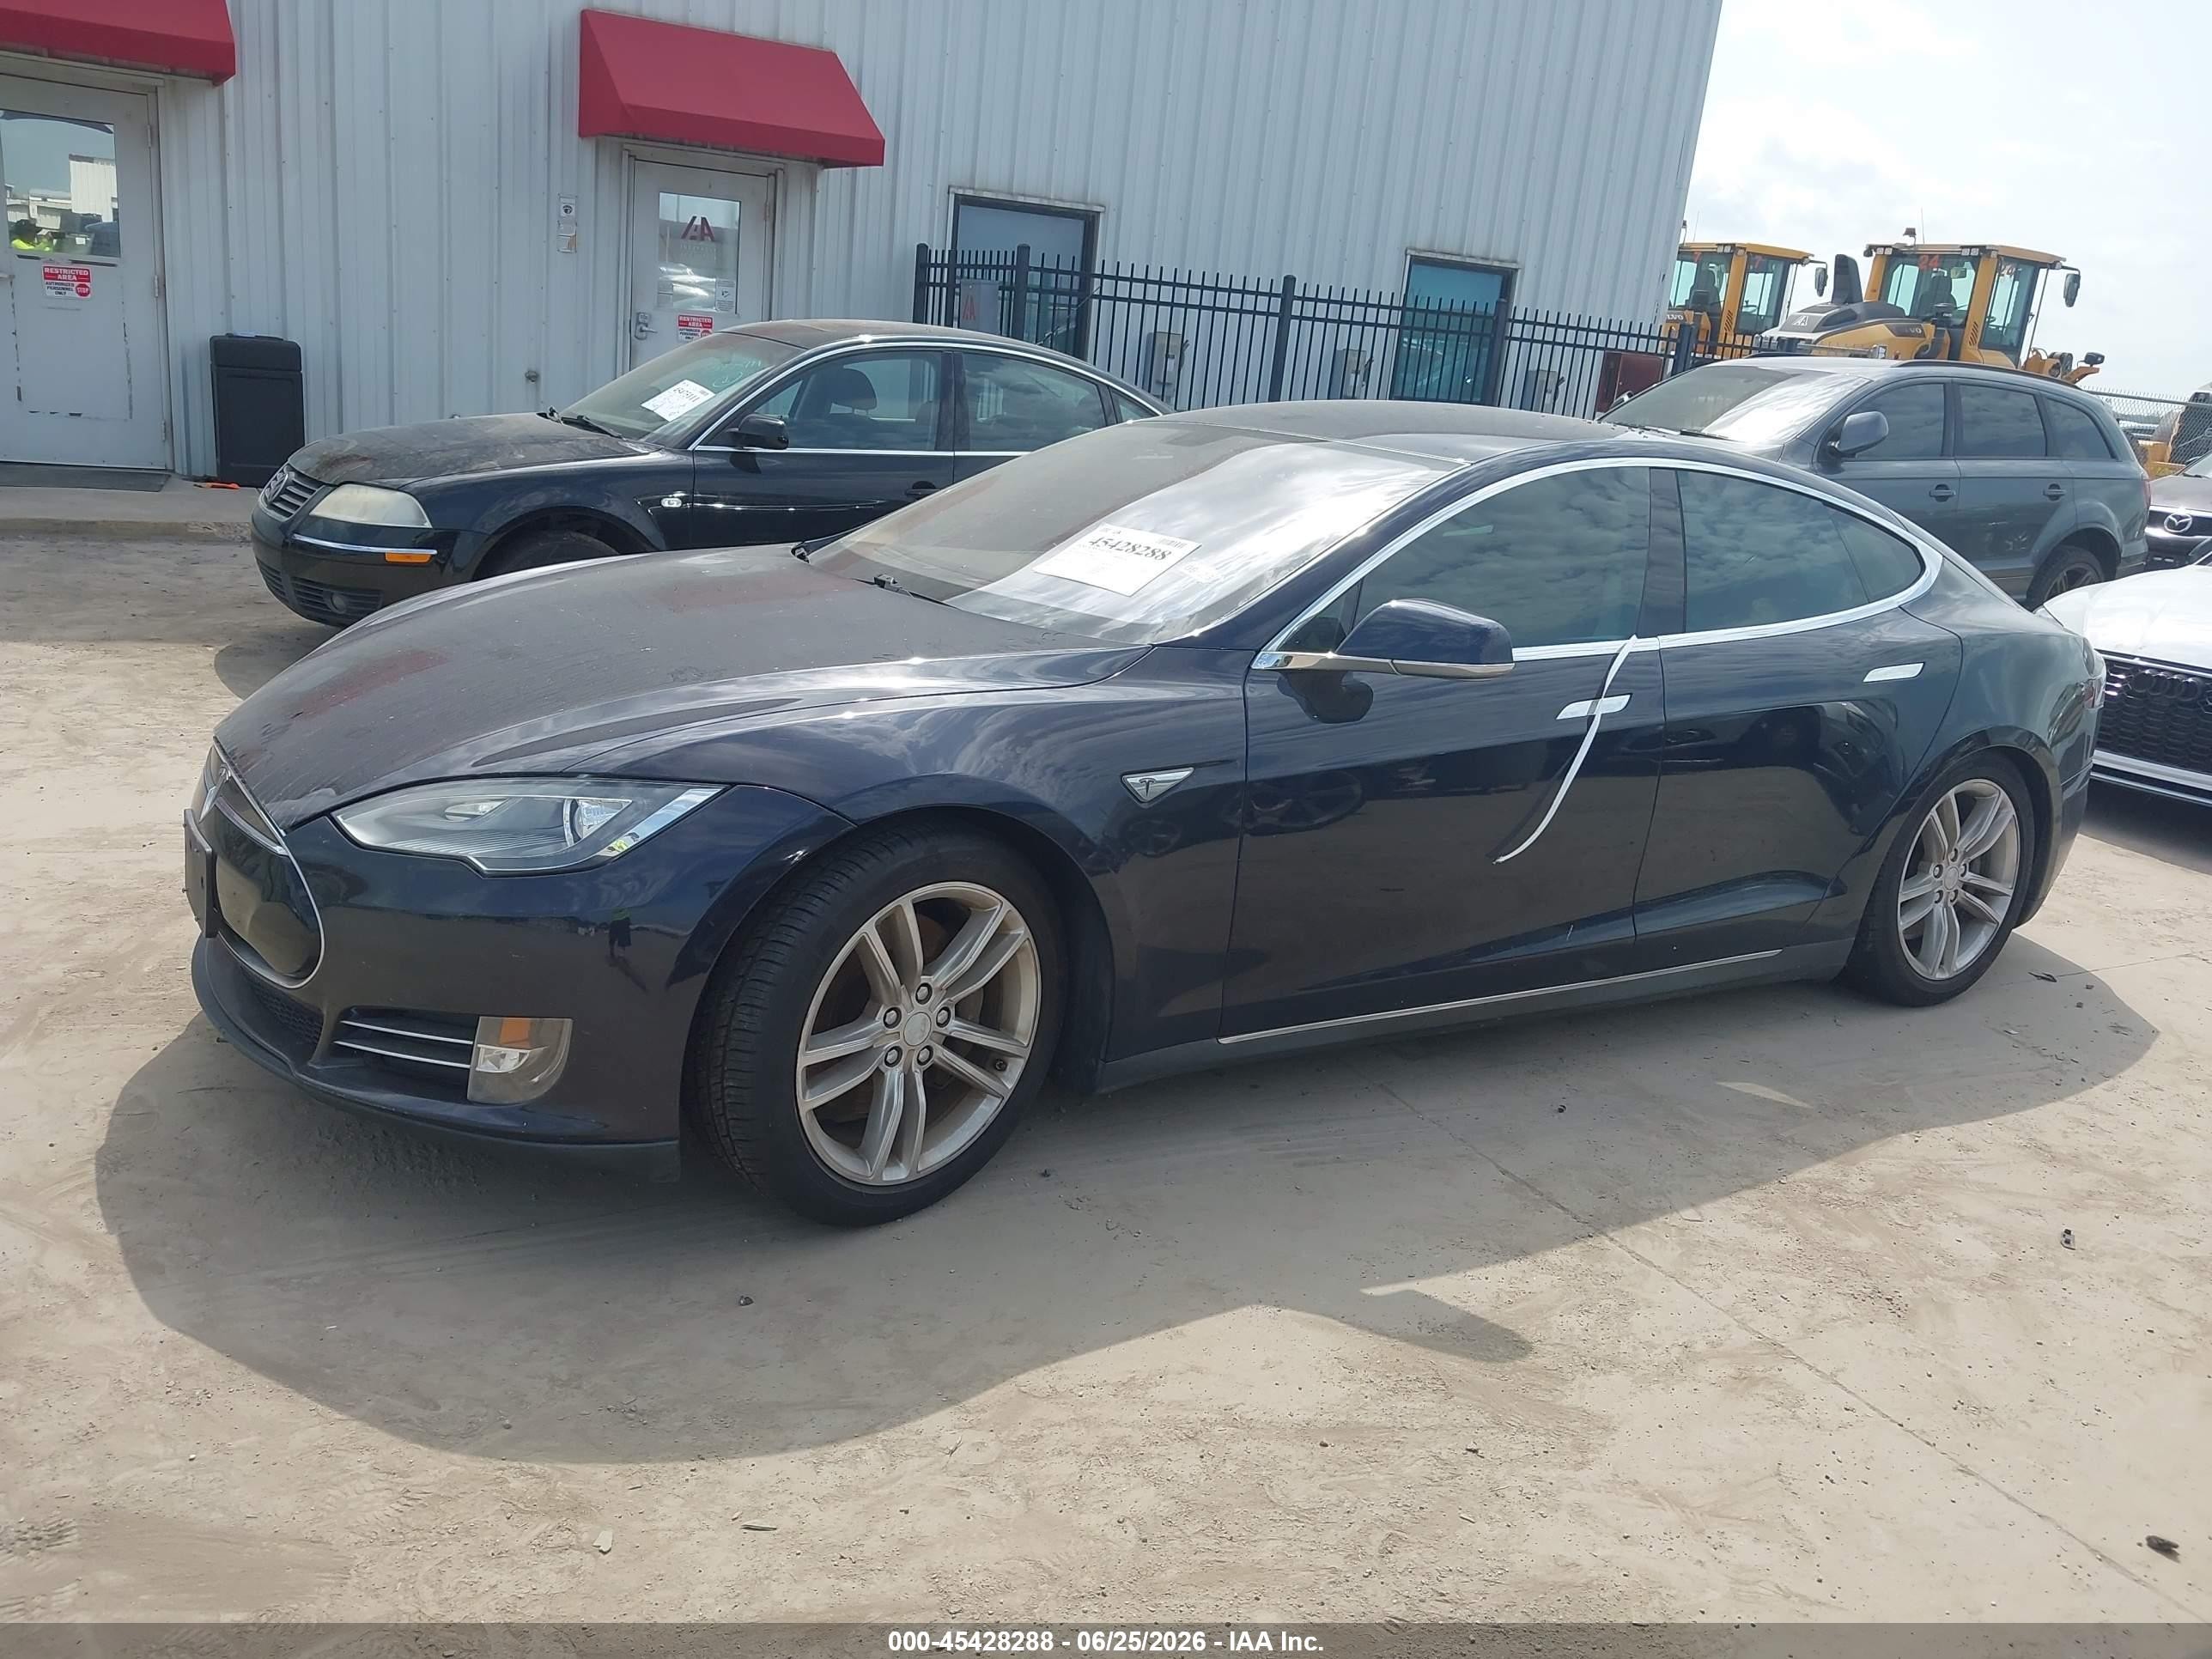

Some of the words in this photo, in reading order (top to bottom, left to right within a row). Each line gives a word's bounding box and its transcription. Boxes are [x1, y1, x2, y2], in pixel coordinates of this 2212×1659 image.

[1918, 254, 1940, 270] 24
[44, 267, 88, 276] RESTRICTED
[1088, 536, 1172, 561] 45428288
